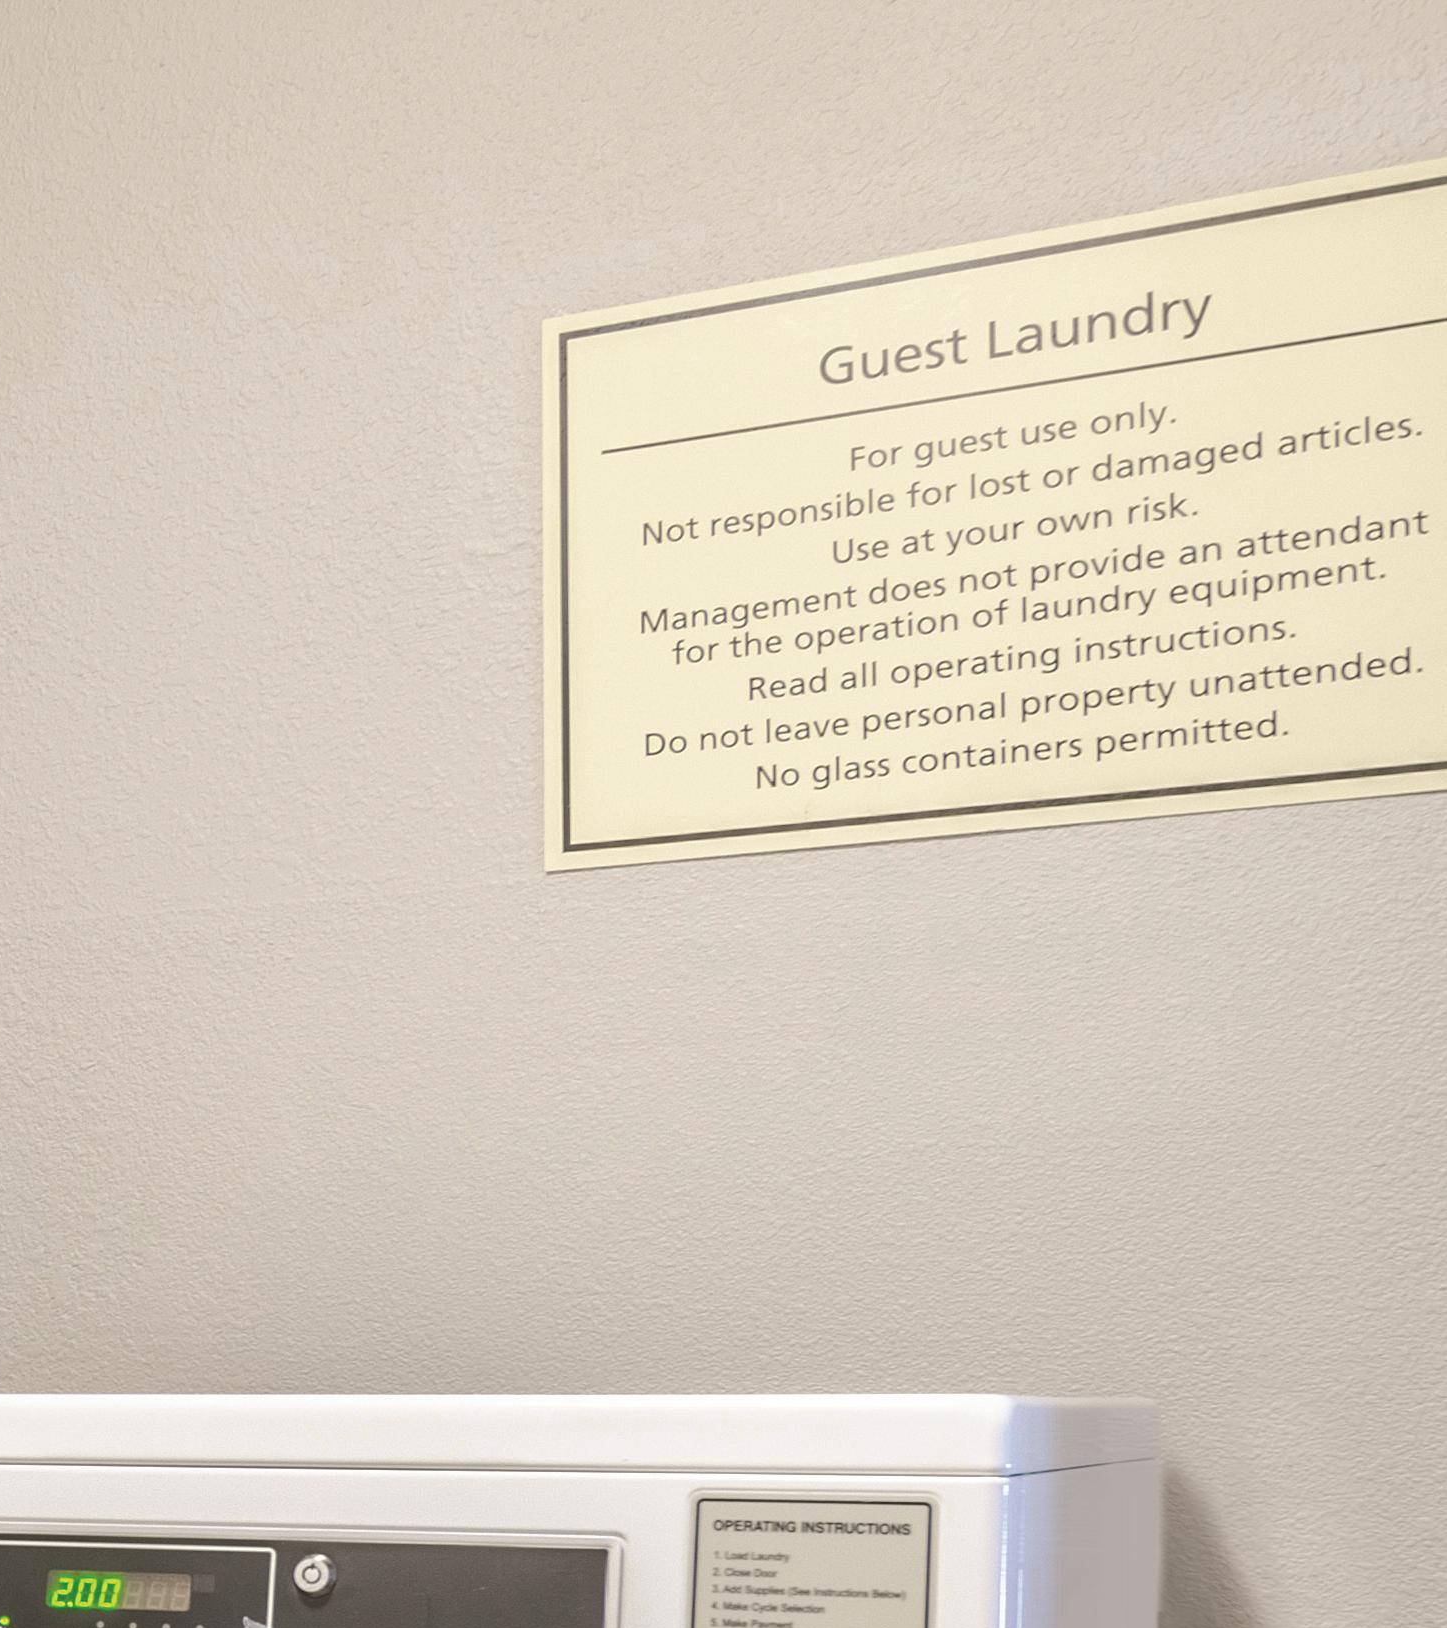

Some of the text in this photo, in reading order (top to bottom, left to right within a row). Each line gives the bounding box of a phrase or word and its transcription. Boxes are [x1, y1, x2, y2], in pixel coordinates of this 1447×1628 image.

[819, 291, 1213, 385] Guest Laundry
[850, 401, 1177, 472] For guest use only.
[642, 415, 1423, 547] Not responsible for lost or damaged articles.
[832, 492, 1198, 564] Use at your own risk.
[640, 510, 1430, 635] Management does not provide an attendant
[671, 556, 1386, 665] for the operation of laundry equipment.
[748, 620, 1296, 701] Read all operating instructions.
[645, 646, 1424, 757] Do not leave personal property unattended.
[756, 709, 1289, 791] No glass containers permitted.
[713, 1520, 911, 1535] OPERATING INSTRUCTIONS
[725, 1552, 749, 1560] Load
[751, 1552, 790, 1563] Laundry
[51, 1577, 122, 1609] 2.00
[725, 1568, 750, 1577] Close
[755, 1569, 777, 1578] Door
[722, 1619, 747, 1628] Make
